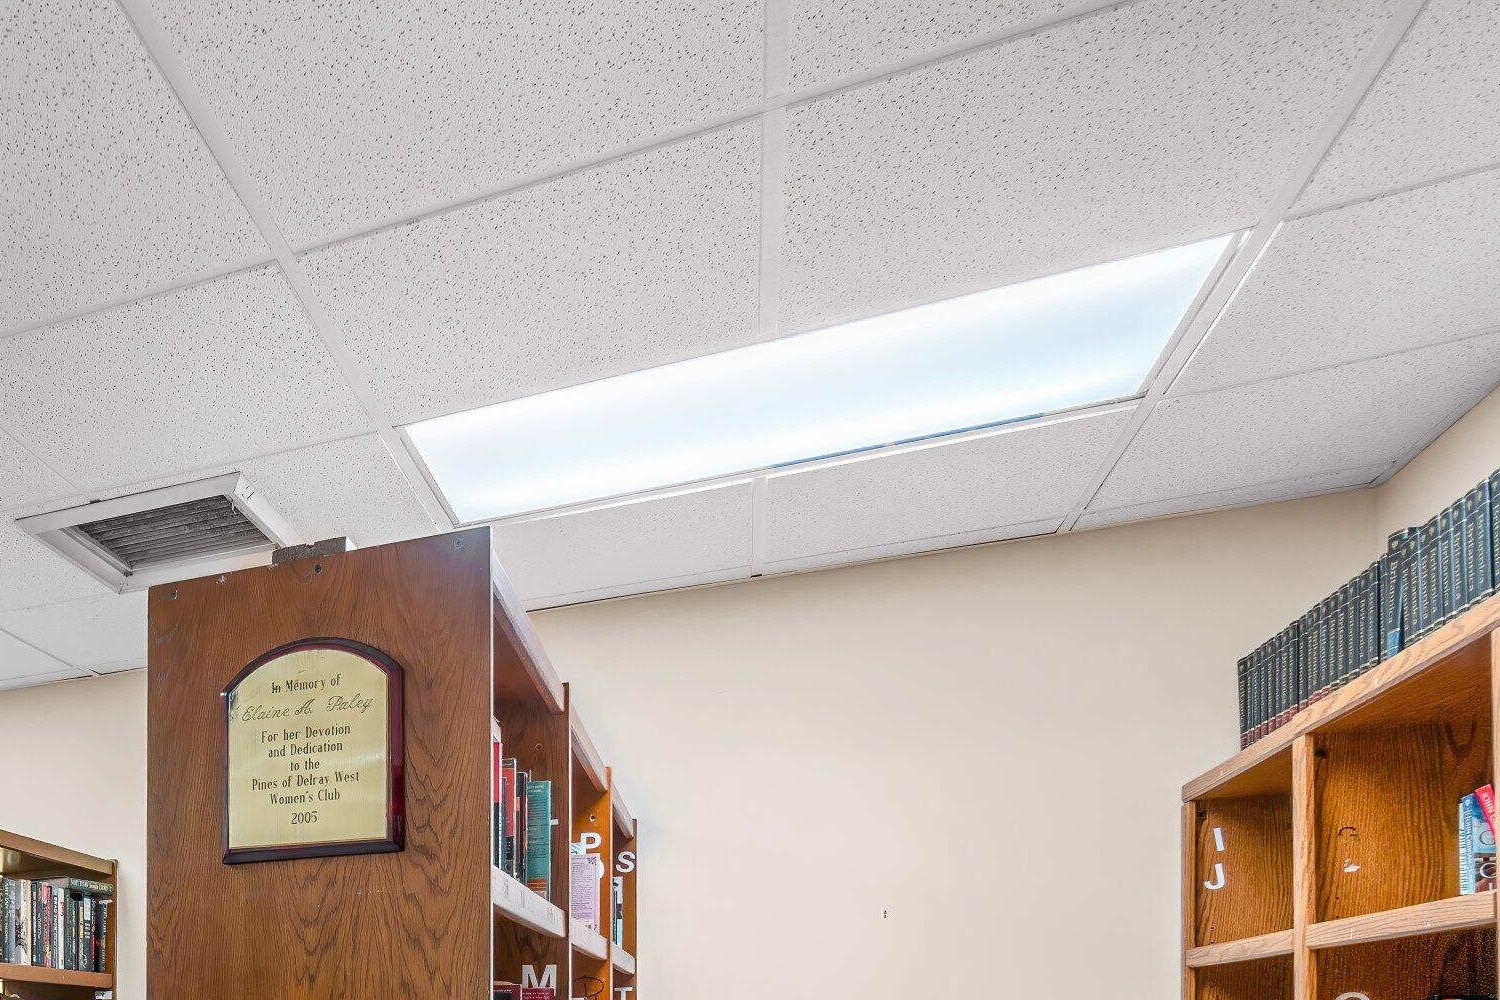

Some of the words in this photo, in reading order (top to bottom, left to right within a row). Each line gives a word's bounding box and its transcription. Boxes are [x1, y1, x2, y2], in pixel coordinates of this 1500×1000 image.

[1454, 532, 1462, 600] Britannica
[1467, 523, 1475, 592] Britannica
[1421, 555, 1429, 620] Britannica
[1430, 547, 1438, 613] Britannica
[1388, 560, 1398, 624] Britannica
[272, 682, 281, 694] In
[286, 678, 325, 693] Memory
[331, 674, 341, 686] of
[242, 705, 290, 722] Elaine
[326, 693, 373, 713] Paley
[261, 730, 278, 743] For
[283, 729, 300, 740] her
[305, 724, 351, 738] Devotion
[268, 745, 286, 758] and
[290, 742, 343, 755] Dedication
[290, 760, 300, 771] to
[305, 759, 320, 770] the
[252, 777, 277, 790] Pines
[282, 776, 292, 788] of
[296, 774, 329, 788] Delray
[335, 771, 359, 783] West
[270, 790, 313, 805] Women's
[318, 789, 340, 801] Club
[1481, 792, 1492, 813] JOHN
[291, 811, 318, 825] 2005
[580, 832, 601, 854] P
[1213, 828, 1225, 851] I
[615, 851, 635, 874] S
[1204, 863, 1225, 890] J
[522, 964, 555, 993] M
